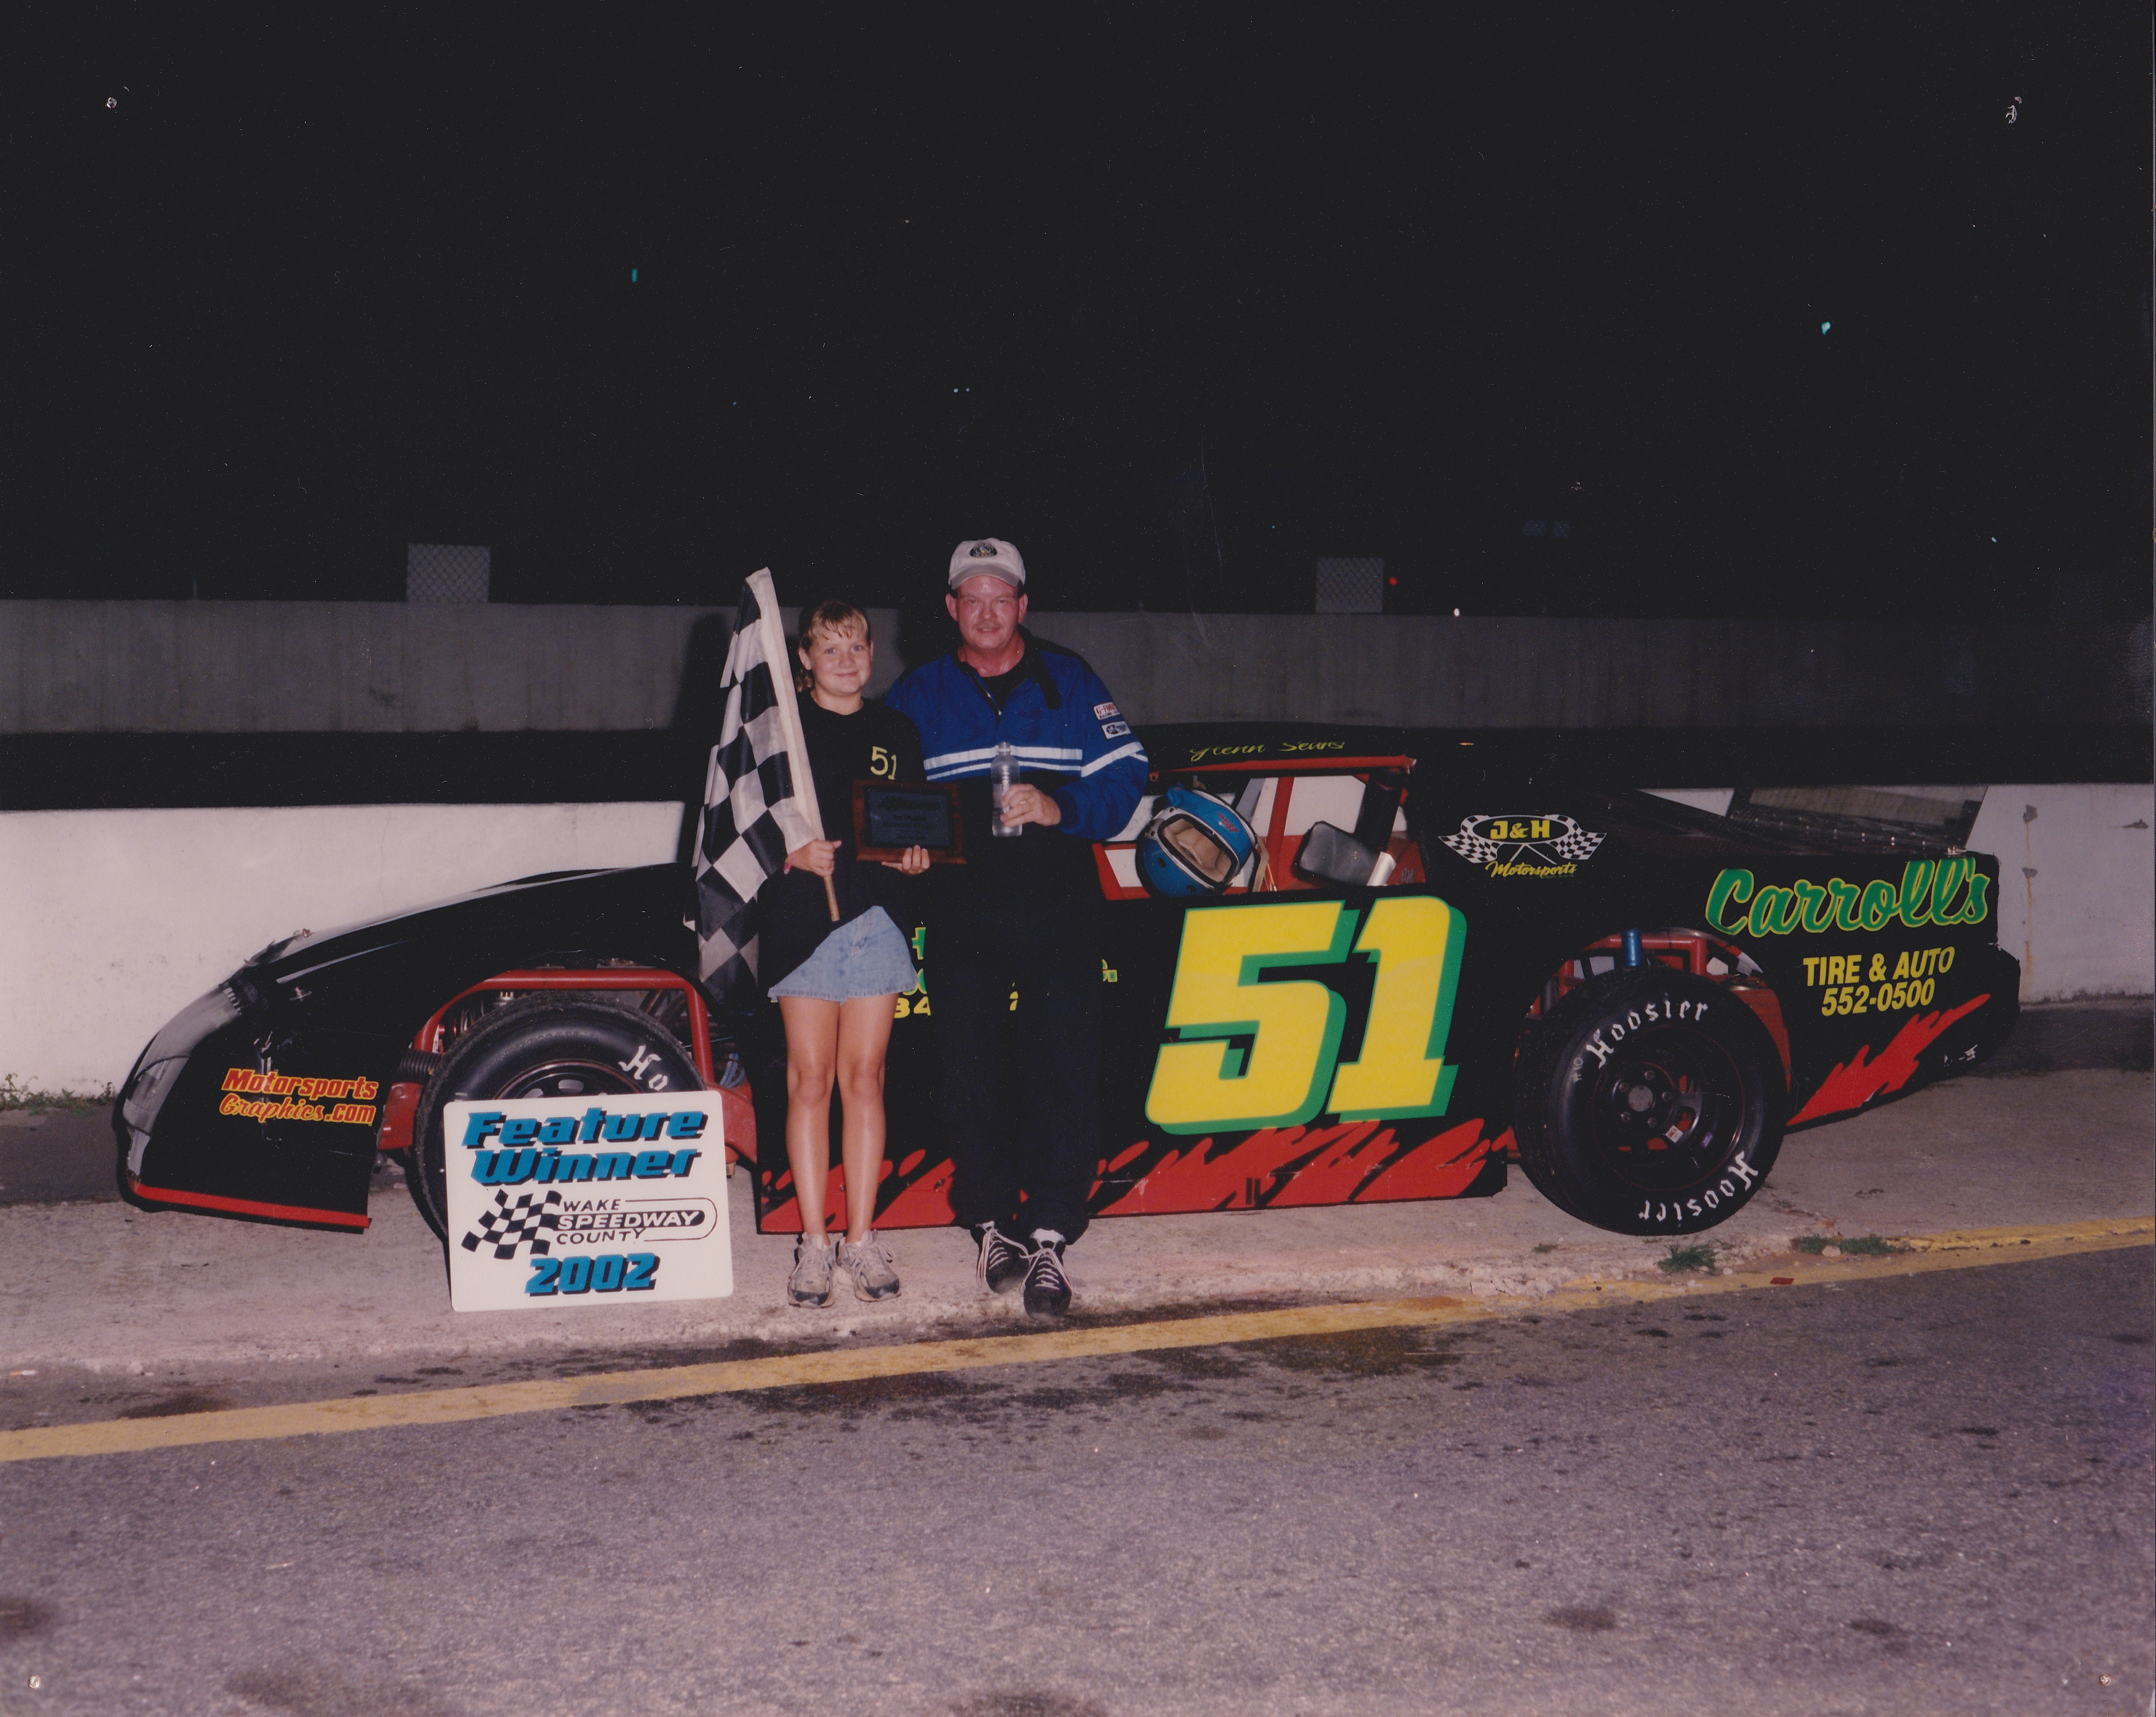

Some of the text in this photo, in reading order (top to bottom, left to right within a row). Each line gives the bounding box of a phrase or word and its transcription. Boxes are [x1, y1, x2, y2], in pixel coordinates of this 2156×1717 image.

[870, 746, 897, 780] 51
[1490, 820, 1550, 840] J&H
[1485, 860, 1577, 878] Motorsports
[1705, 857, 1991, 937] Carroll's
[1803, 946, 1955, 986] TIRE & AUTO
[1145, 895, 1467, 1134] 51
[1821, 978, 1935, 1016] 552-0500
[1586, 992, 1708, 1069] Hoosier
[221, 1068, 379, 1101] Motorsports
[219, 1093, 376, 1127] Graphics.com
[461, 1107, 709, 1149] Feature
[470, 1147, 702, 1187] Winner
[562, 1198, 622, 1212] WAKE
[1638, 1151, 1759, 1228] Hoosier
[556, 1228, 644, 1245] COUNTY
[558, 1211, 700, 1231] SPEEDWAY
[524, 1252, 661, 1297] 2002
